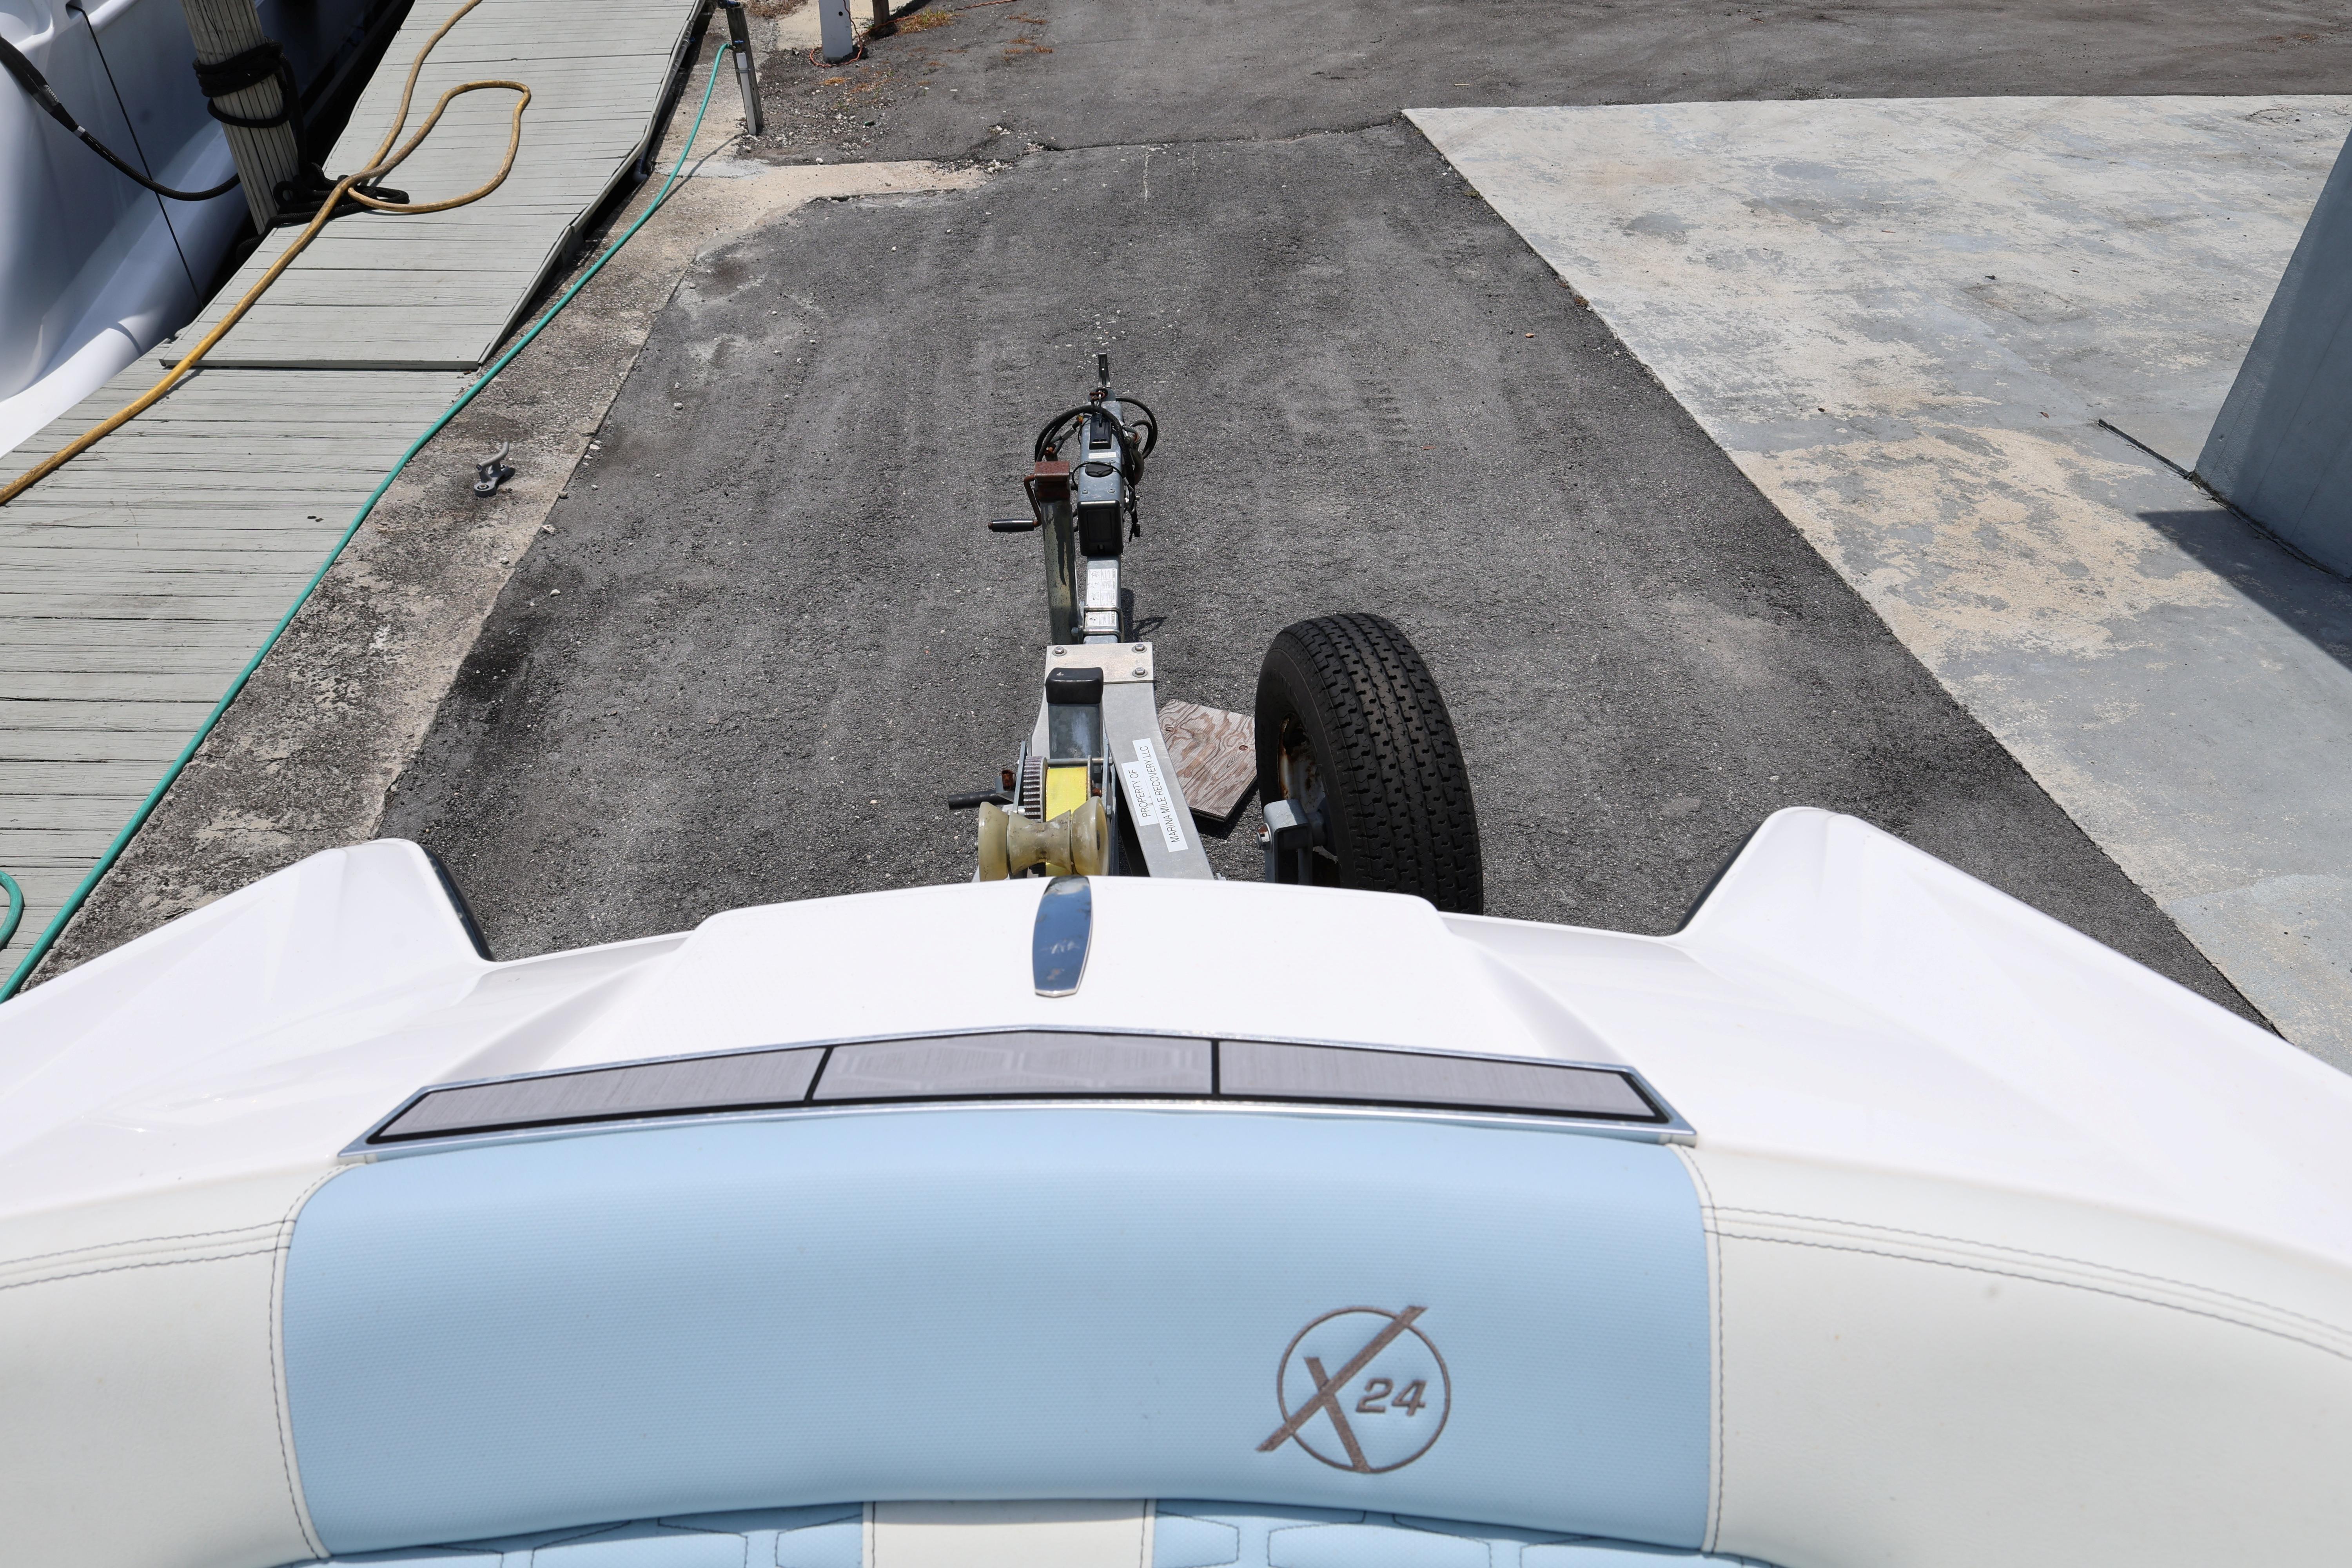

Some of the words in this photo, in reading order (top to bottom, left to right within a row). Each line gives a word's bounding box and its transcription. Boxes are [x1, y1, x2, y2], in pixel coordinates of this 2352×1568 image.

[1128, 769, 1139, 779] OF
[1132, 780, 1151, 817] PROPERTY
[1156, 797, 1170, 813] MILE
[1163, 814, 1180, 842] MARINA
